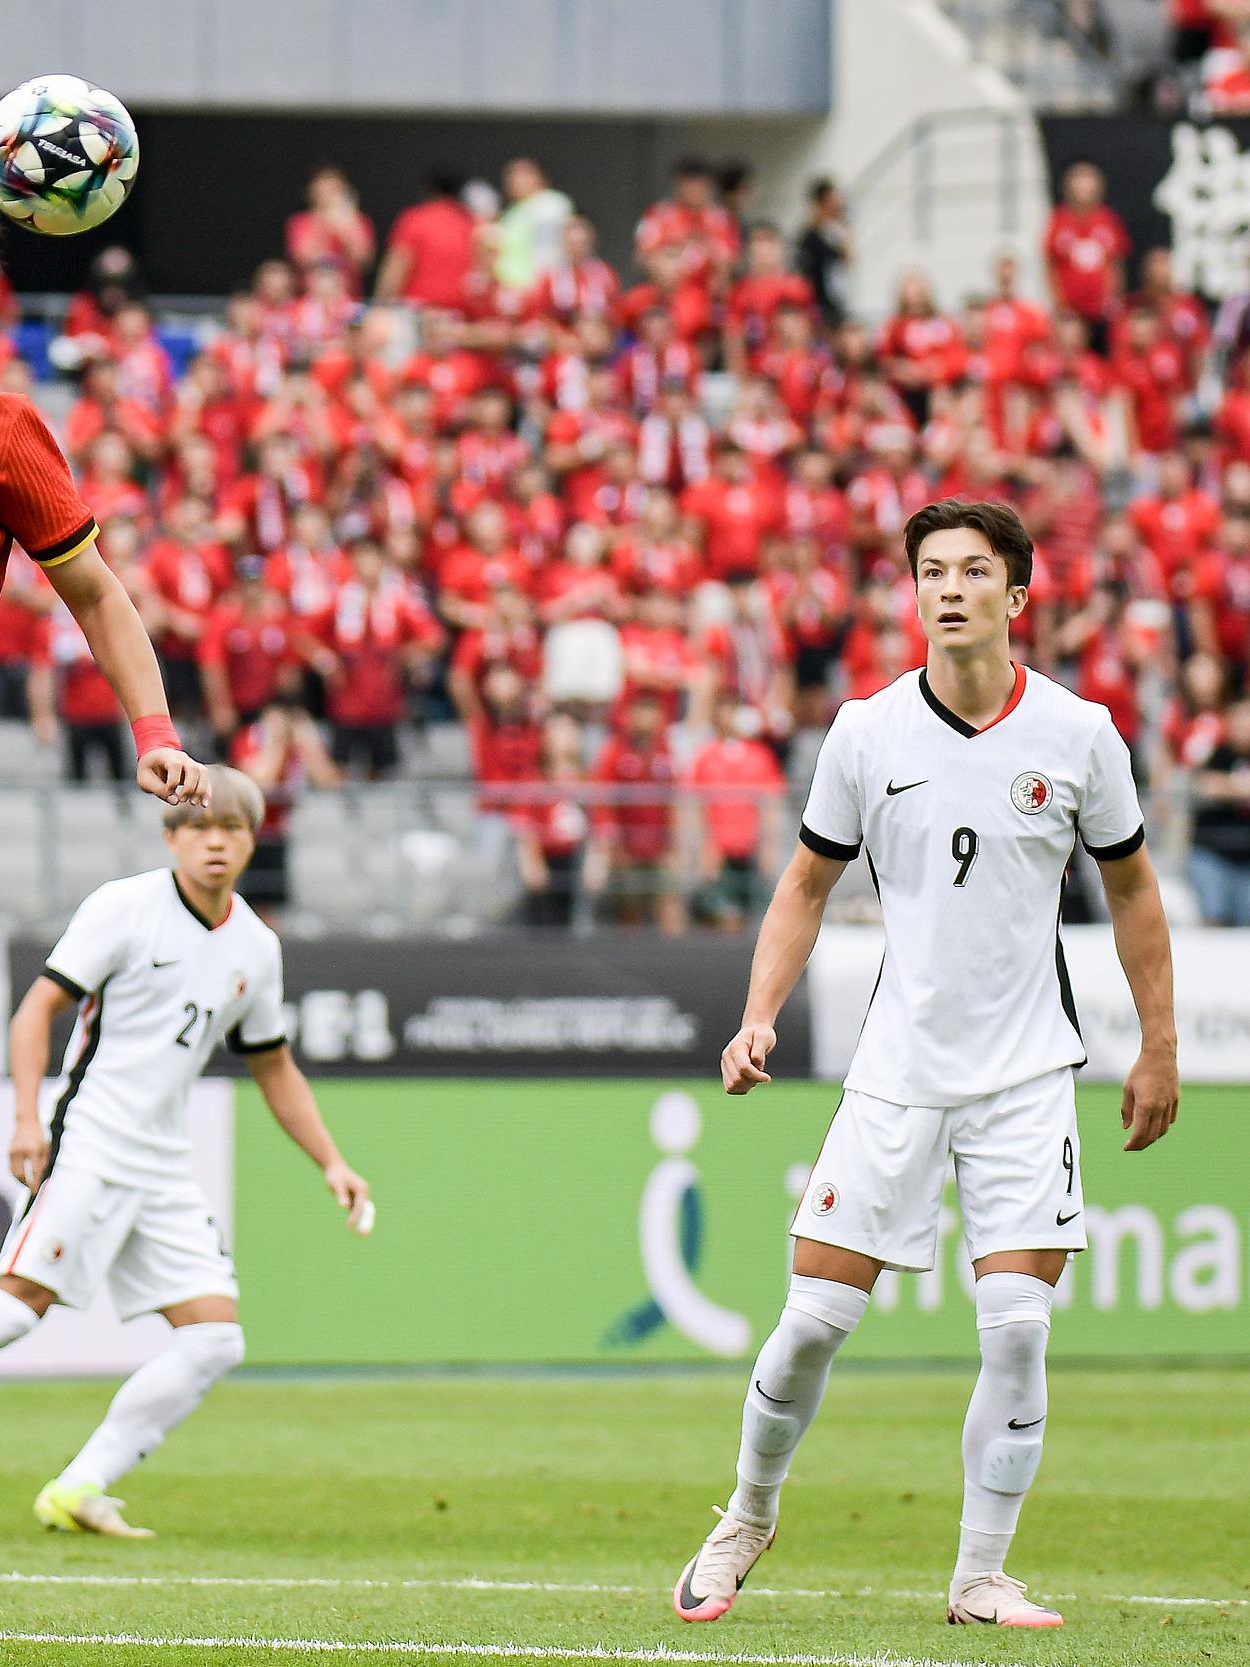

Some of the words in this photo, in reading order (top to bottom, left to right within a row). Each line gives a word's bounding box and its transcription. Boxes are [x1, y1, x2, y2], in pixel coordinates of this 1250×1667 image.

[37, 138, 87, 167] TSUBASA
[951, 826, 980, 888] 9
[1062, 1135, 1073, 1197] 9
